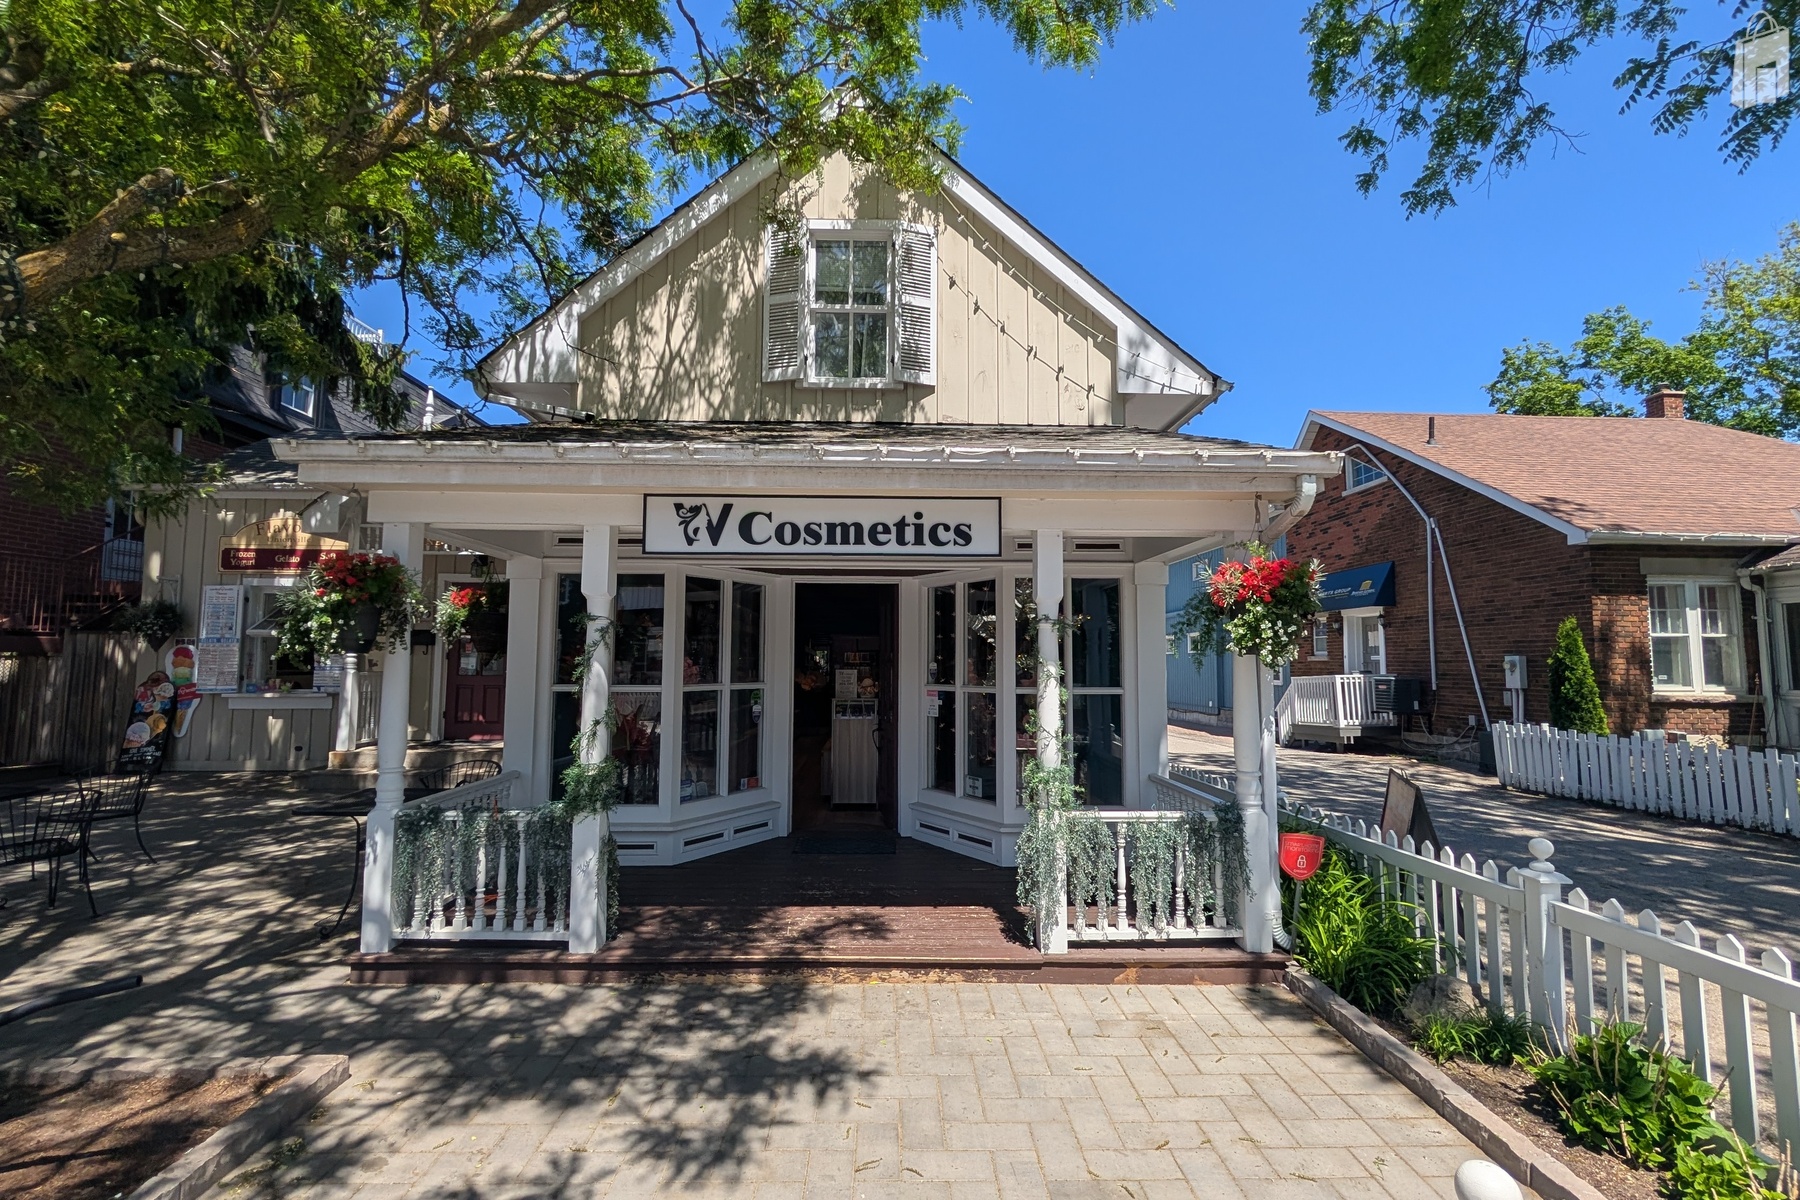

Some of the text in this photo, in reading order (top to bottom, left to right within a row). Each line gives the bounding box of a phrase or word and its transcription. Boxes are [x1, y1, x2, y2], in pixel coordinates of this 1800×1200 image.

[738, 511, 973, 546] Cosmetics
[230, 550, 256, 558] Frozen
[275, 554, 300, 563] Gelato
[230, 559, 256, 567] Yogurt
